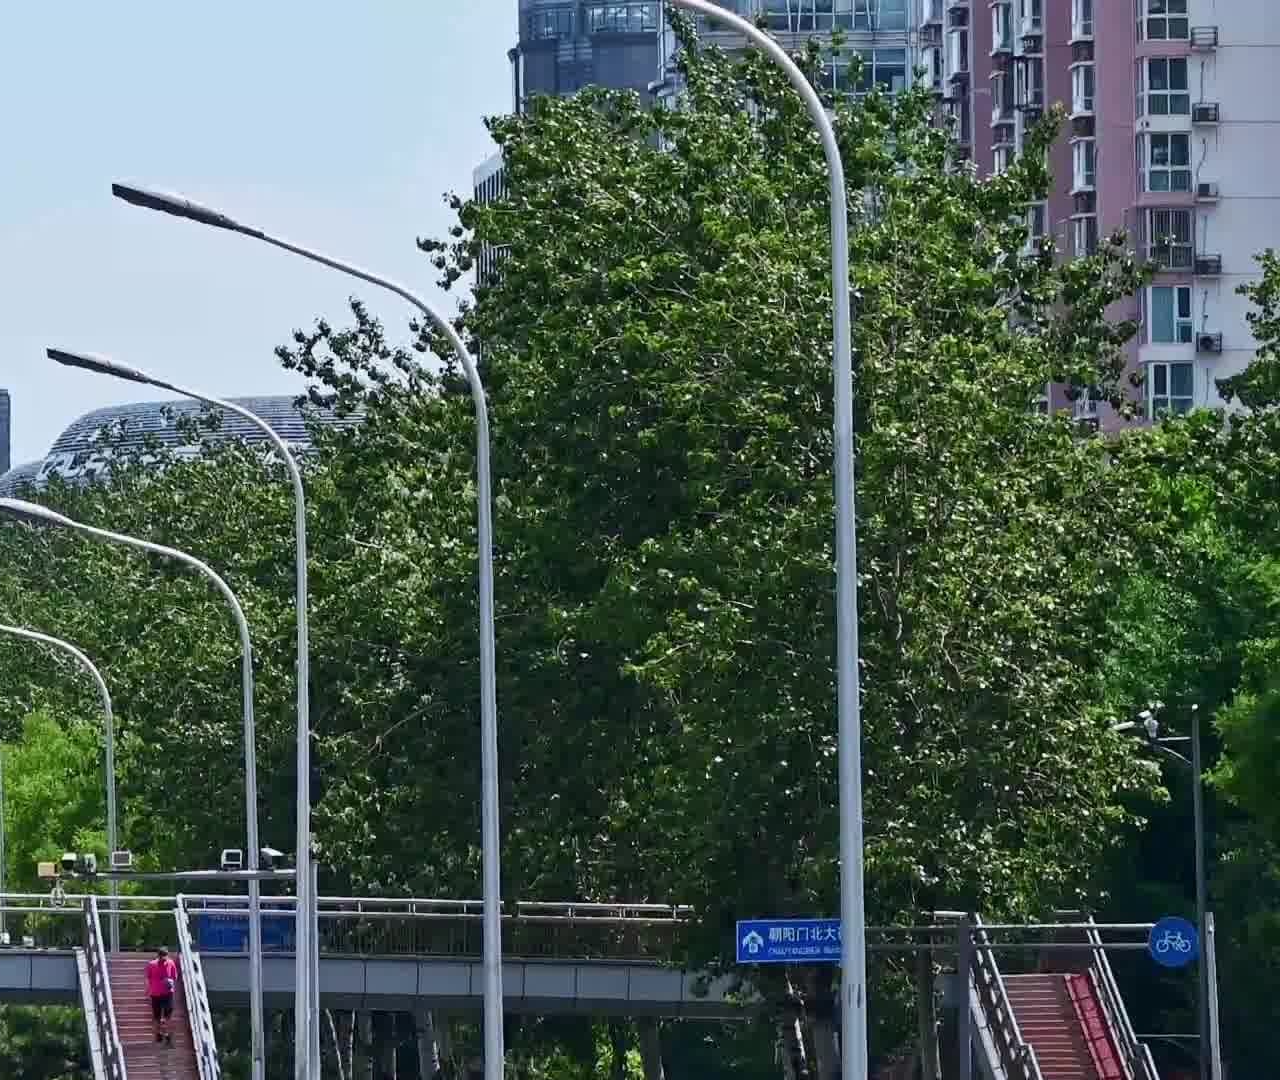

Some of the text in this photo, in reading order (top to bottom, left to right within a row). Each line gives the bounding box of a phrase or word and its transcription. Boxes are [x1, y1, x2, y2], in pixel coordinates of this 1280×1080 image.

[768, 927, 842, 942] 朝阳门北大
